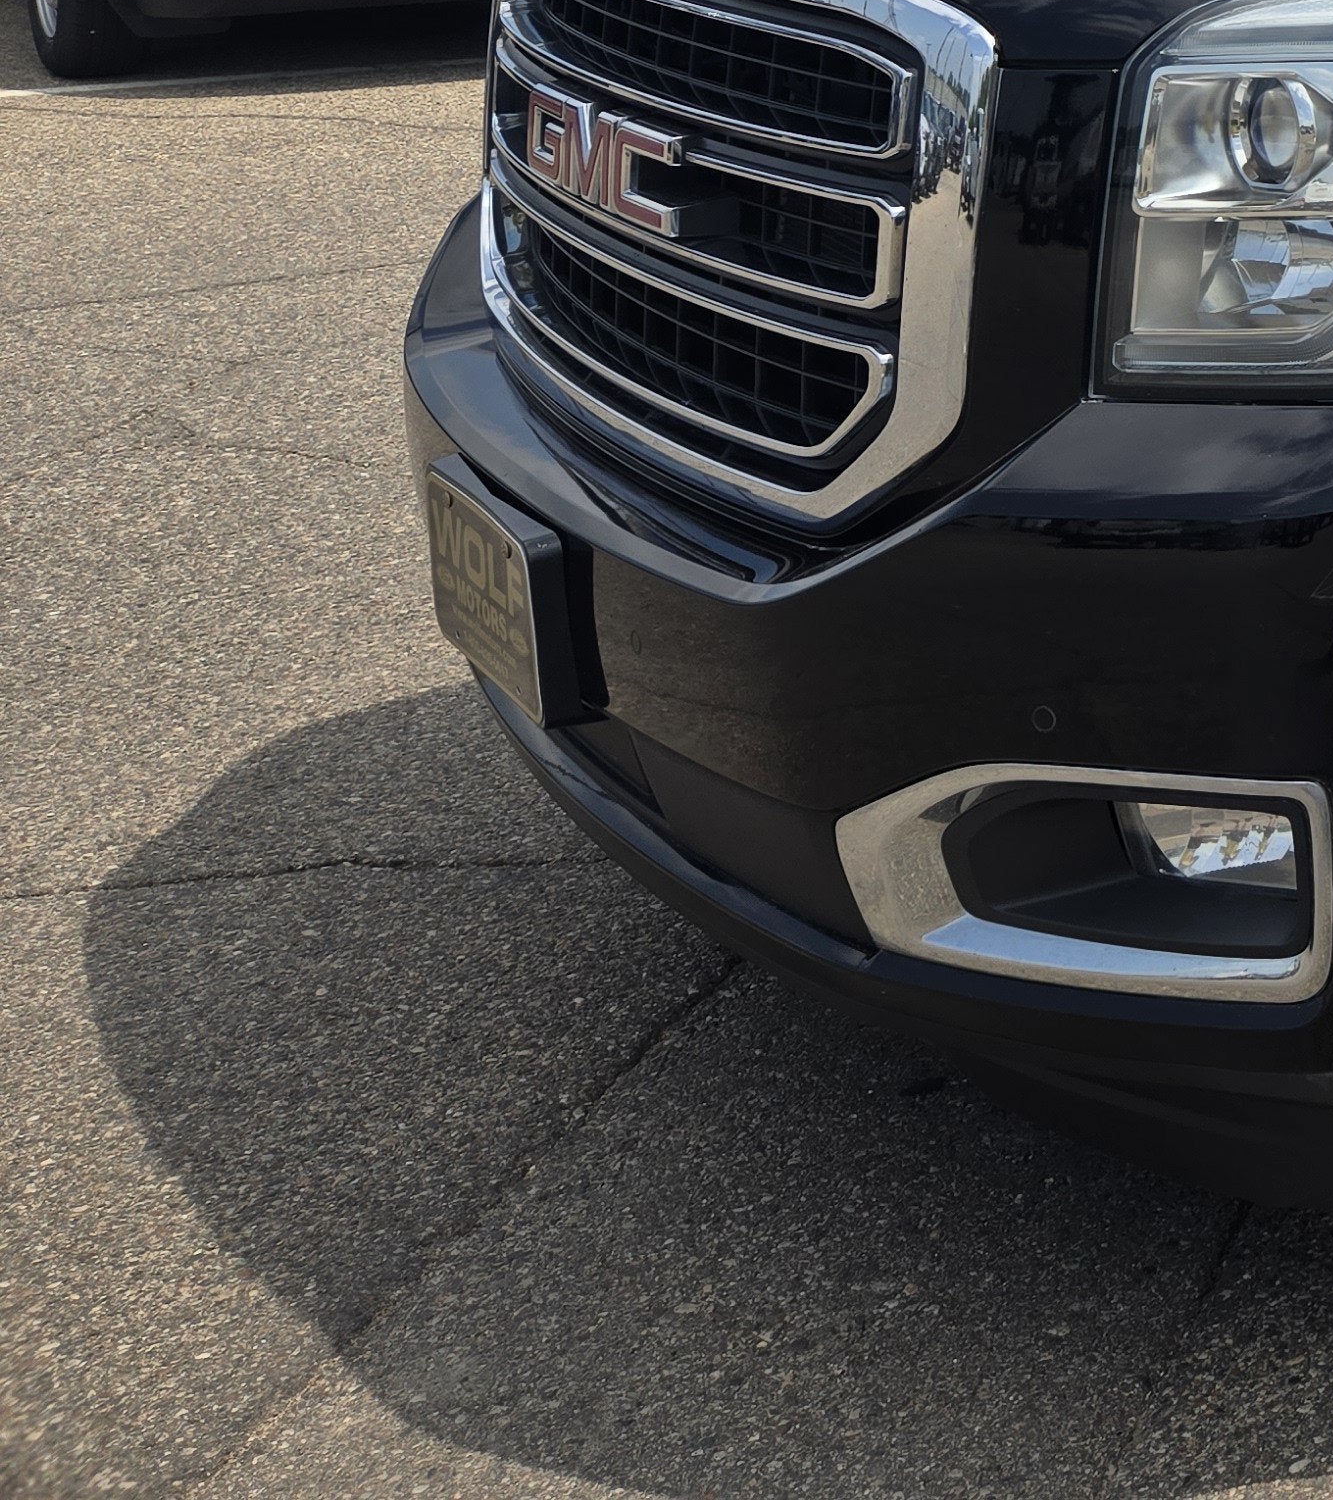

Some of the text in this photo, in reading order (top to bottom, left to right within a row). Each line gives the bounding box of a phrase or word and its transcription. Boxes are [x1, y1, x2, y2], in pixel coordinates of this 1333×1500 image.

[527, 83, 684, 237] GMC
[431, 497, 525, 618] WOLF
[456, 577, 508, 643] MOTORS
